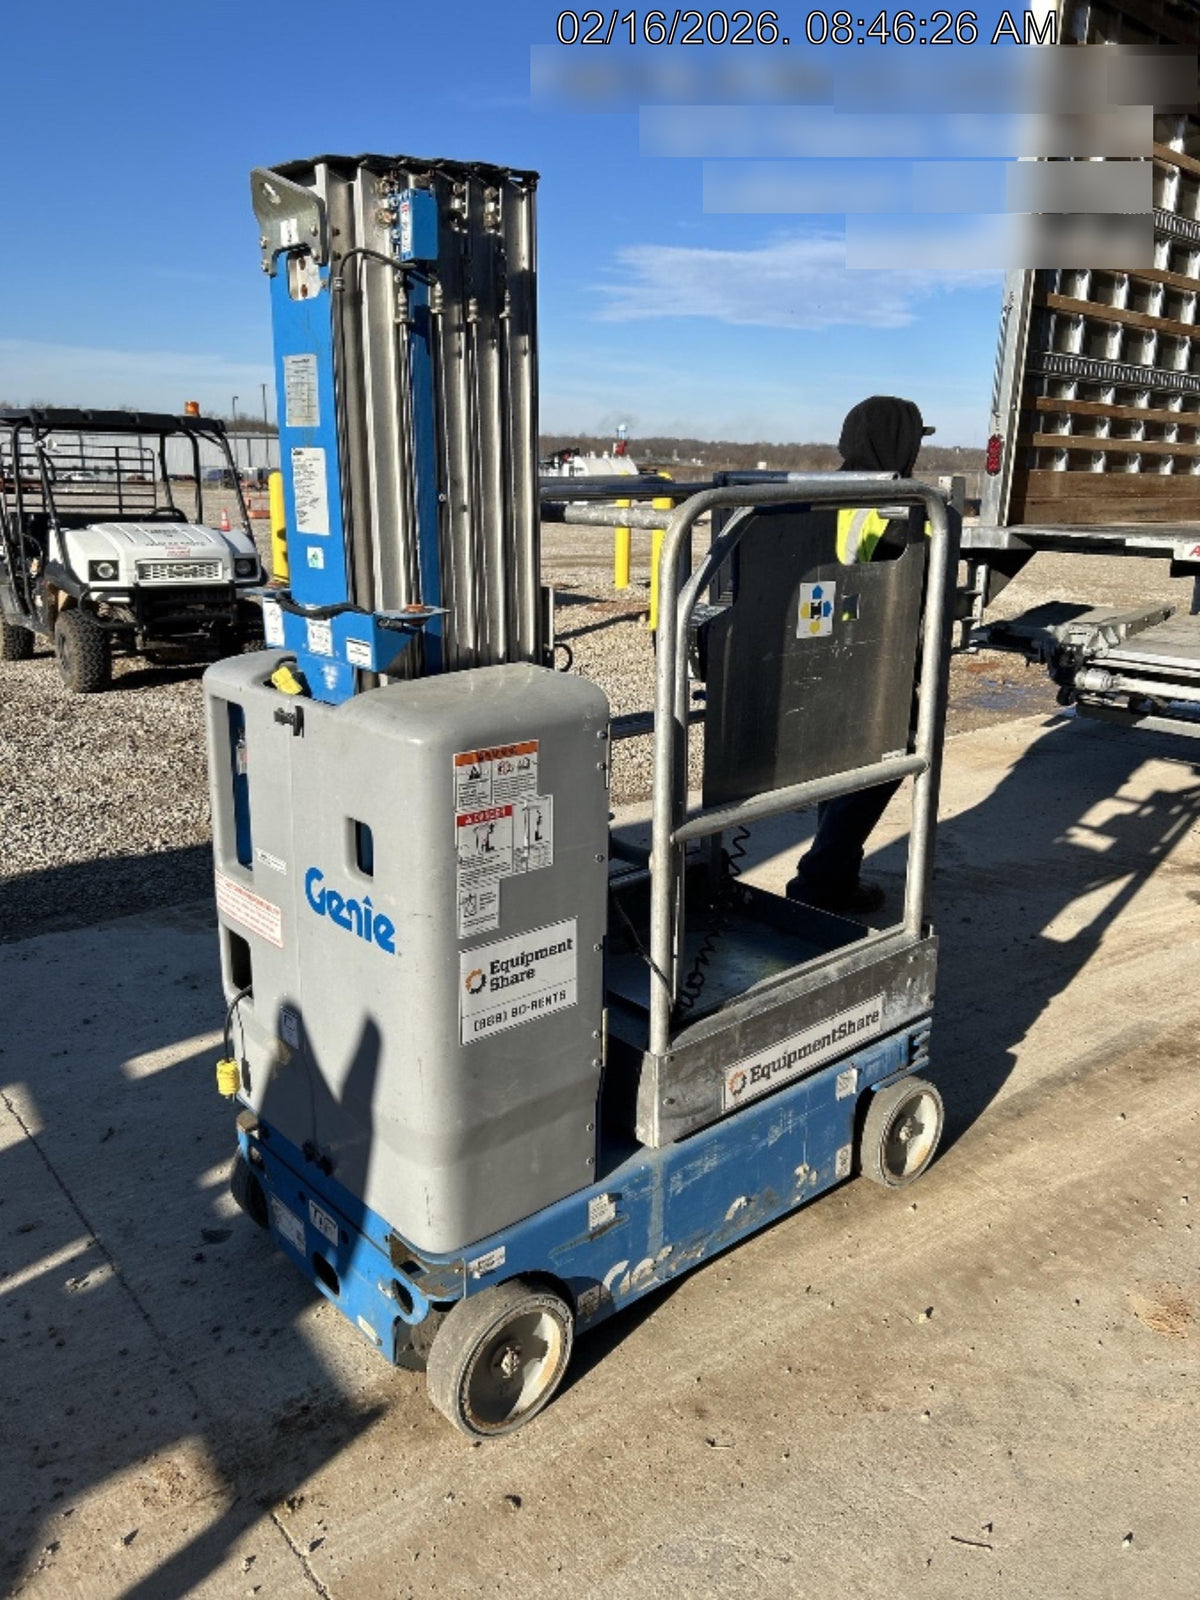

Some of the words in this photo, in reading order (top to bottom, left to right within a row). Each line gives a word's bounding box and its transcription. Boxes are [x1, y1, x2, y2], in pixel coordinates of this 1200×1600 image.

[305, 867, 396, 955] Genie
[490, 938, 573, 975] Equipment
[490, 968, 536, 992] Share
[749, 1009, 880, 1085] EquipmentShare
